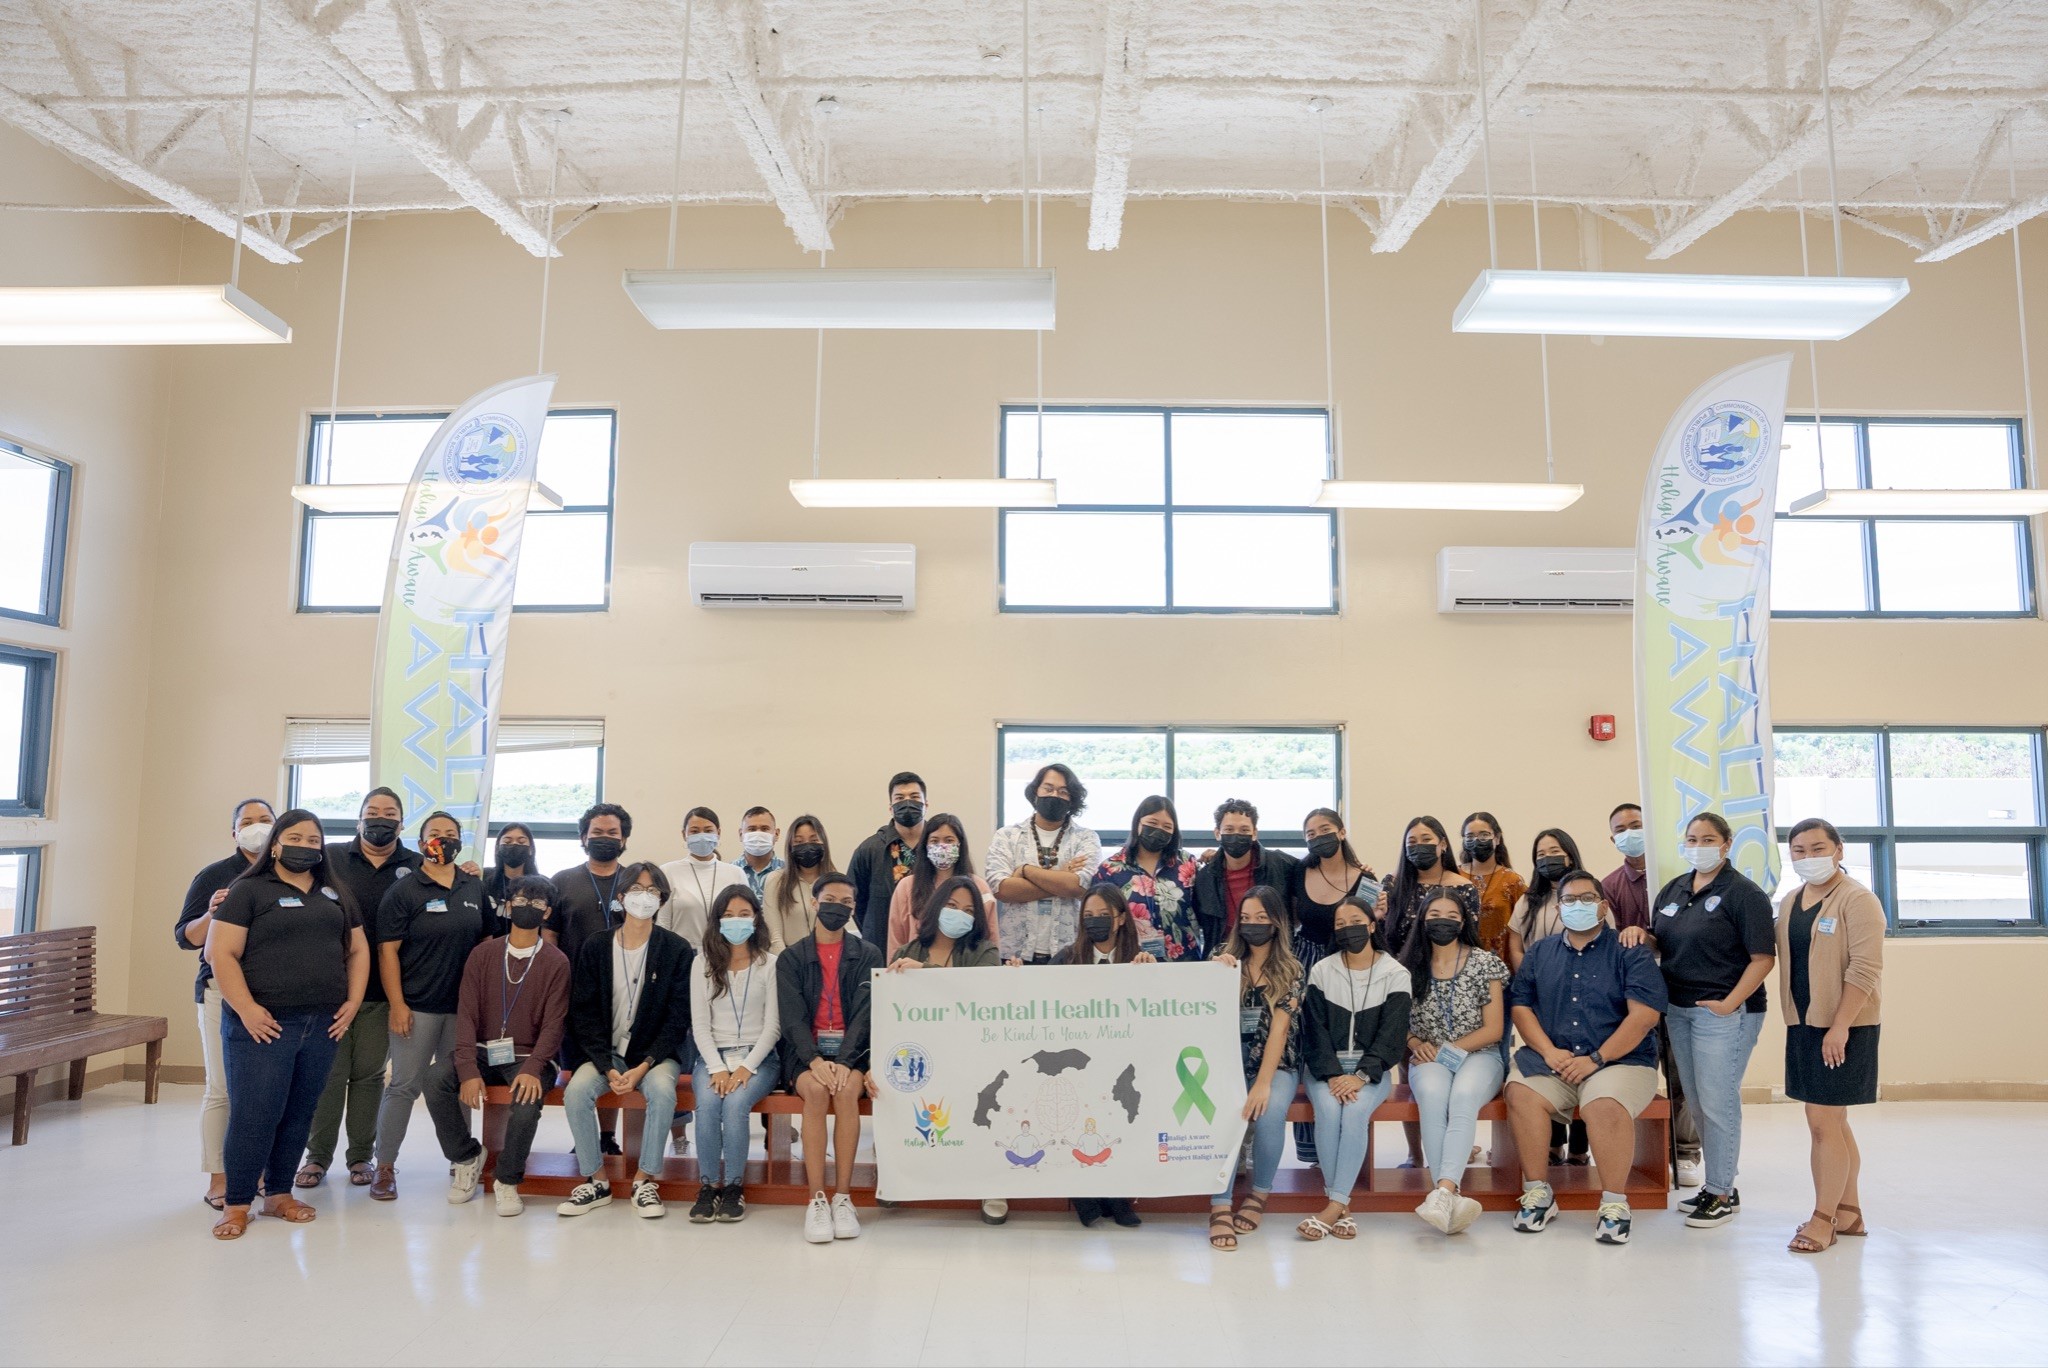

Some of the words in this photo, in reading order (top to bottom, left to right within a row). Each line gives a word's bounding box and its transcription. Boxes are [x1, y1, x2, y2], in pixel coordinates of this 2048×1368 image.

[1690, 413, 1708, 433] PUBLIC
[1684, 434, 1692, 458] SCHOOL
[1687, 459, 1705, 478] SYSTEM
[1656, 464, 1680, 520] Haligi
[404, 546, 427, 607] Aware
[1656, 544, 1678, 607] Aware
[1669, 621, 1714, 873] AWA
[892, 1000, 950, 1023] Your
[954, 999, 1036, 1021] Mental
[1042, 997, 1120, 1020] Health
[1126, 995, 1217, 1018] Matters
[981, 1026, 998, 1043] Be
[1003, 1025, 1038, 1042] Kind
[1042, 1026, 1055, 1040] To
[1060, 1026, 1092, 1042] Your
[1096, 1023, 1134, 1040] Mind
